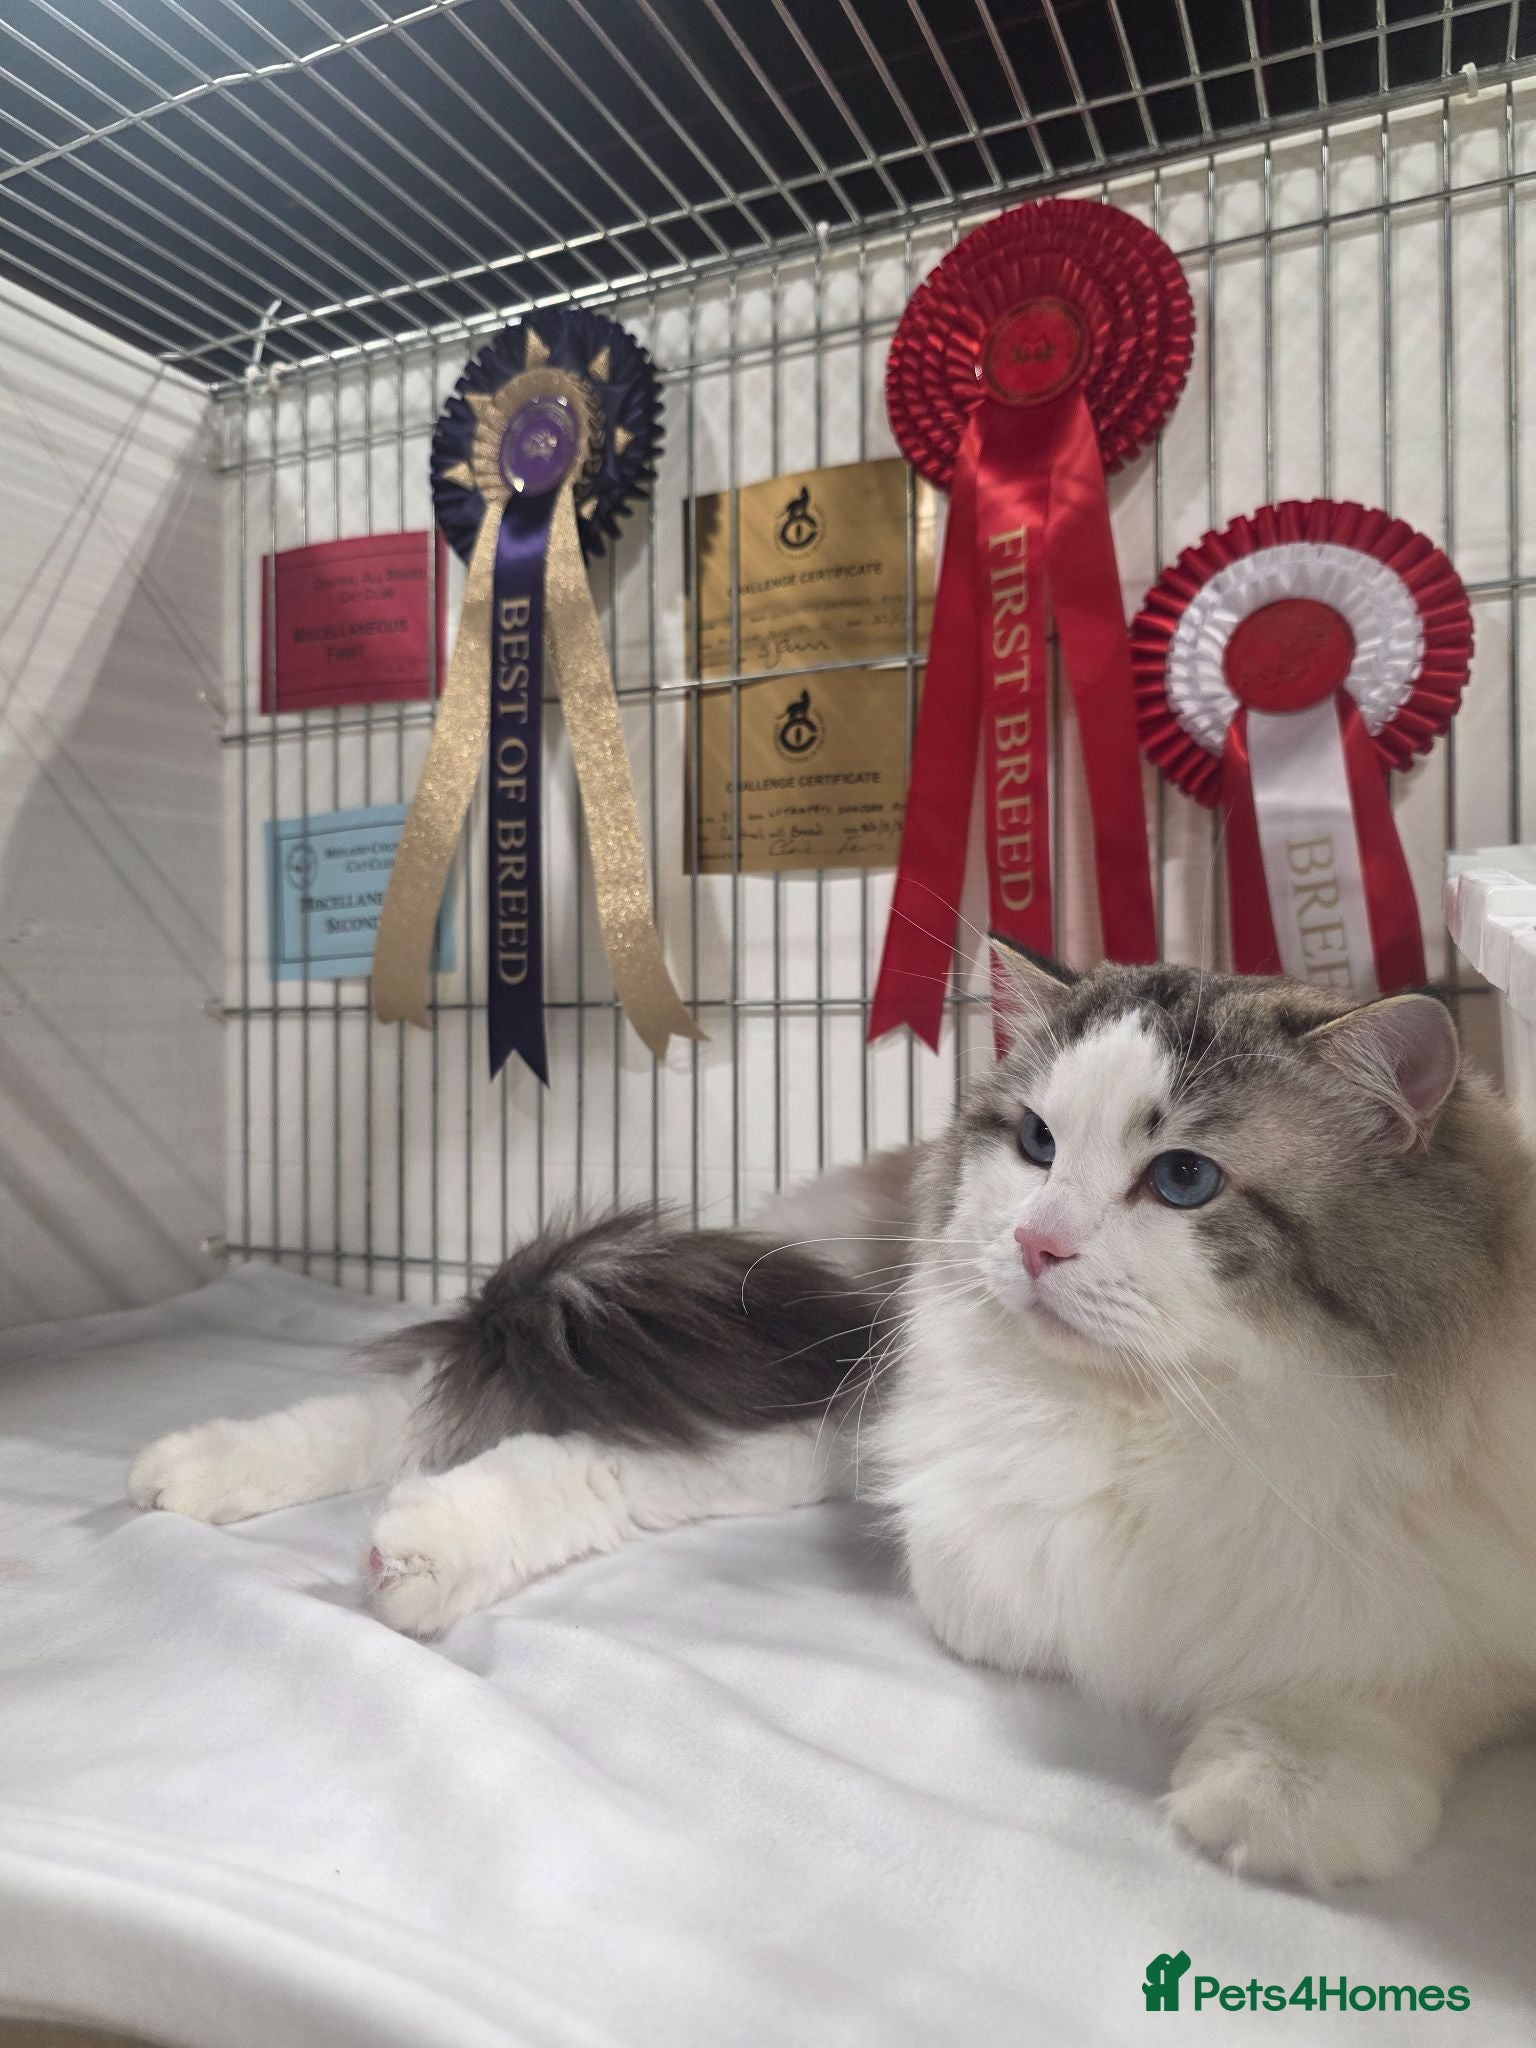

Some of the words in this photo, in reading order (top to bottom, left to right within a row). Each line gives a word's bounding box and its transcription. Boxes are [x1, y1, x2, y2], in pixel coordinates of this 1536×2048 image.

[727, 573, 796, 598] CALLENGE
[800, 562, 883, 584] CERTIFICATE
[988, 524, 1031, 693] FIRST
[497, 594, 531, 725] BEST
[496, 737, 528, 803] OF
[727, 776, 795, 794] CALLENGE
[798, 771, 881, 788] CERTIFICATE
[995, 709, 1035, 912] BREED
[496, 818, 528, 986] BREED
[1286, 833, 1354, 991] BREE
